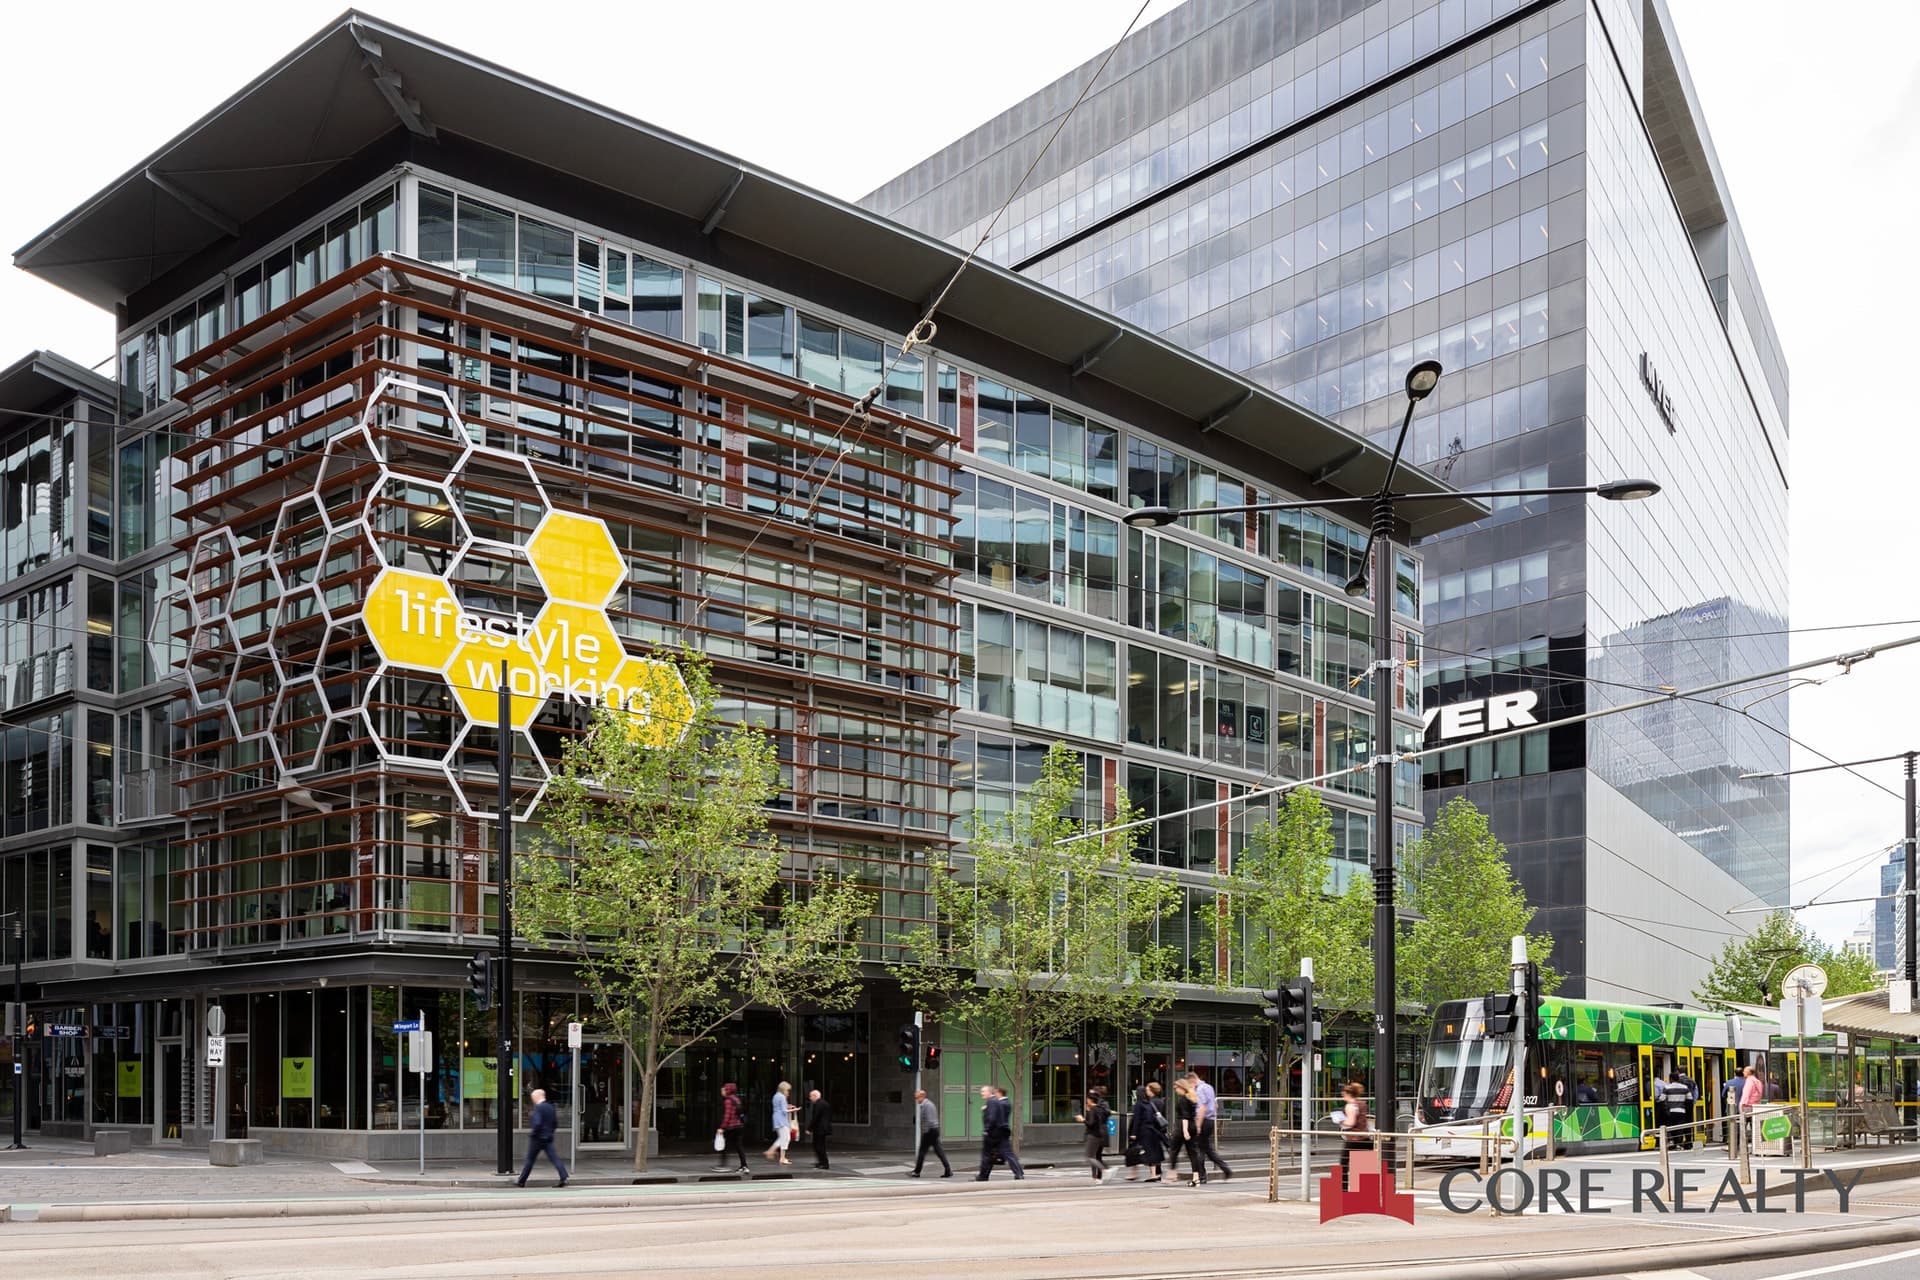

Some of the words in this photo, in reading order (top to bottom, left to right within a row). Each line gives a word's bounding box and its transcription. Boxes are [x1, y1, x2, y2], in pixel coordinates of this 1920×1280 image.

[395, 589, 600, 666] lifestyle
[466, 659, 650, 725] working
[210, 1039, 223, 1047] ONE
